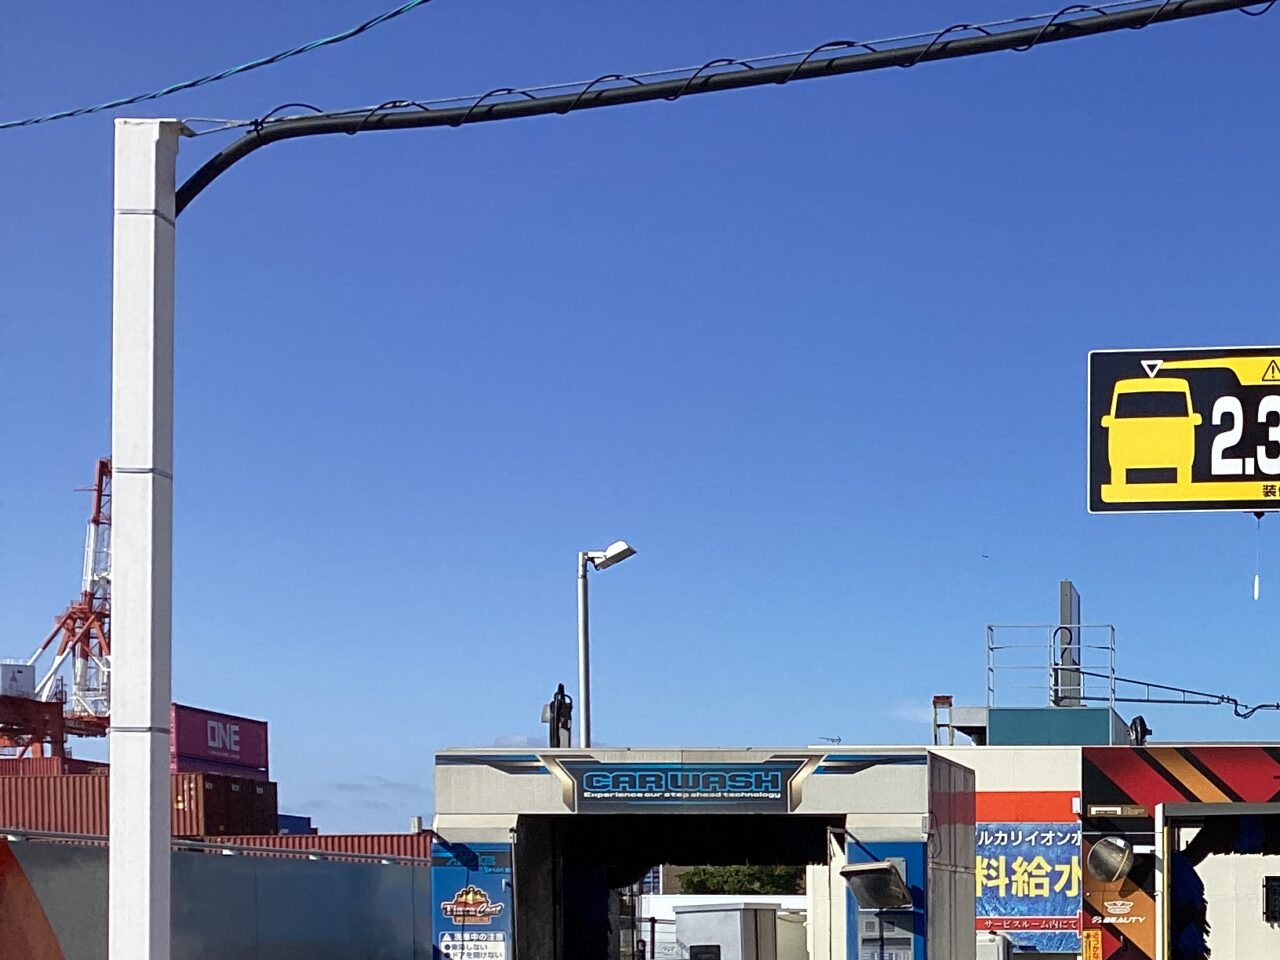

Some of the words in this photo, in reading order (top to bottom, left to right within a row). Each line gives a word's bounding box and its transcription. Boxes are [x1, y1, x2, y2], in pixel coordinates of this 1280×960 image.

[207, 720, 240, 751] ONE
[583, 771, 665, 792] CAR
[667, 771, 781, 792] WASH
[976, 831, 1081, 846] ルカリイオン水
[443, 904, 476, 916] Tiara
[984, 919, 1078, 929] サービスルーム内にて
[1103, 916, 1146, 924] BEAUTY
